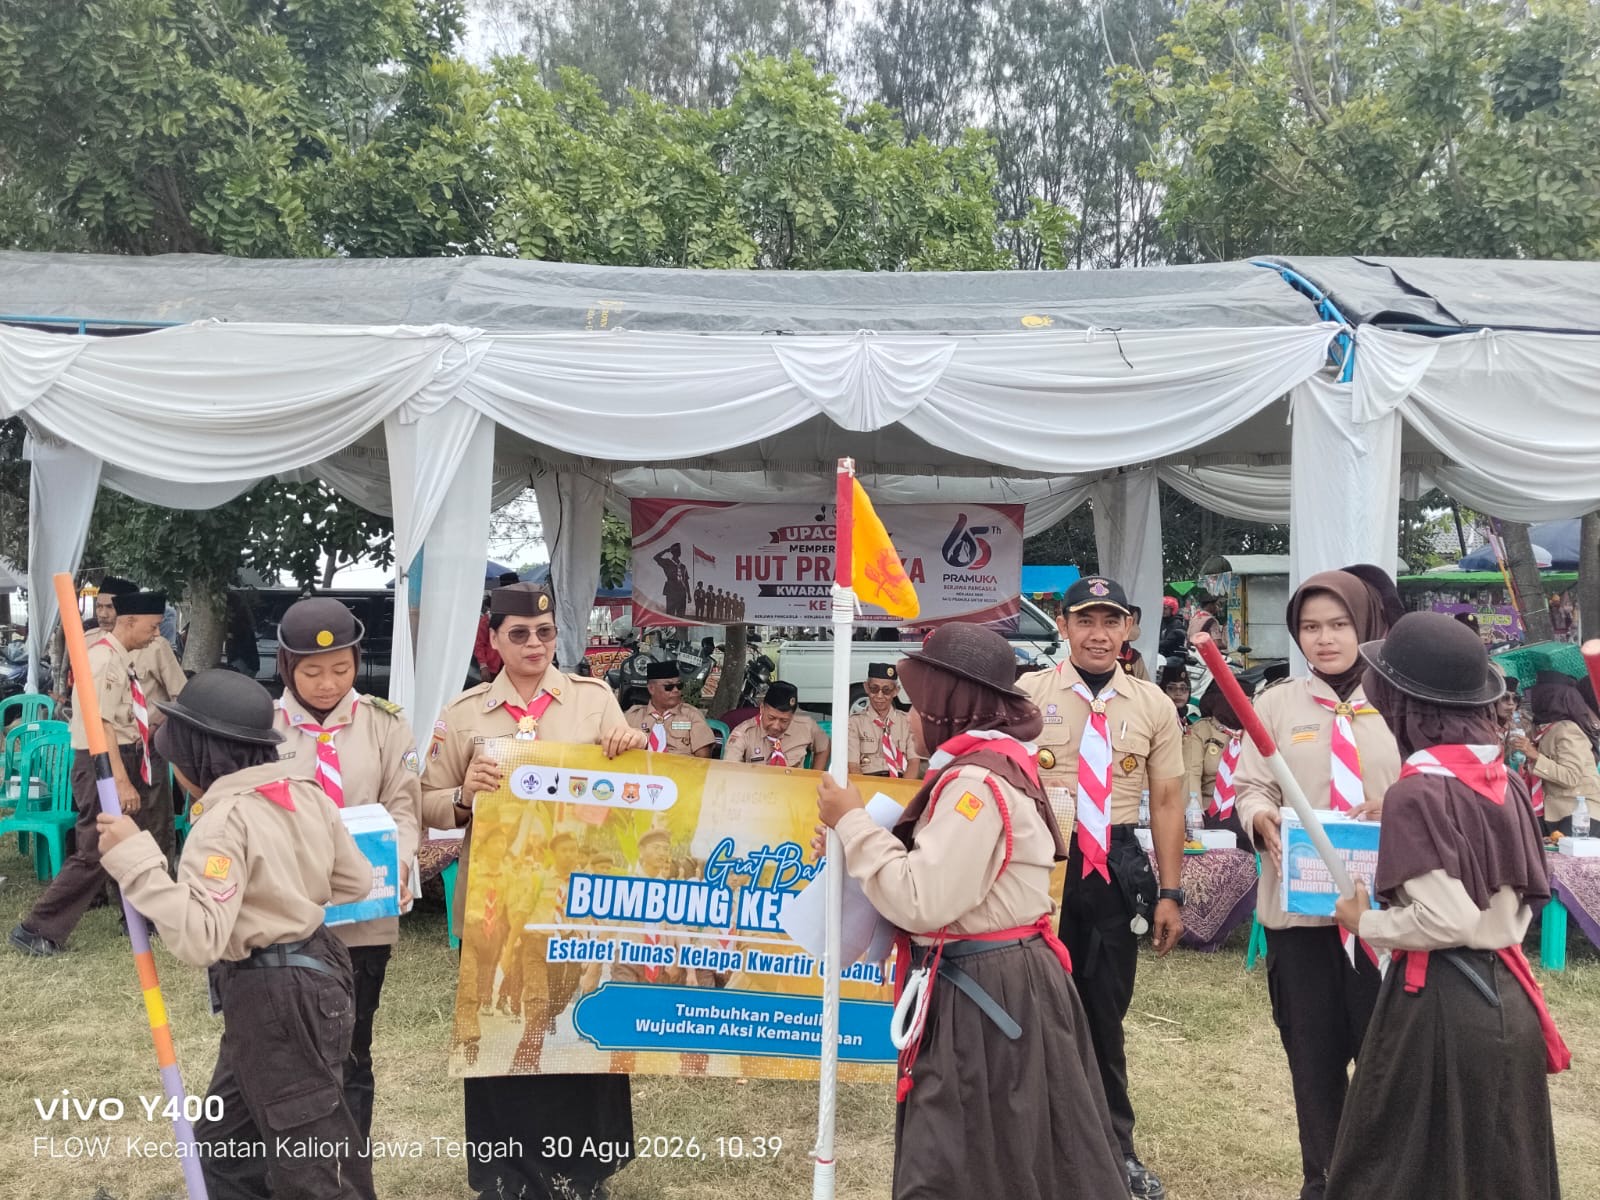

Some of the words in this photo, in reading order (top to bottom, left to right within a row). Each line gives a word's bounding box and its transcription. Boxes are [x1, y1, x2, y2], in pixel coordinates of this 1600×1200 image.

[786, 526, 836, 541] UPAC
[789, 545, 836, 553] MEMPER
[735, 555, 788, 581] HUT
[942, 573, 998, 584] PRAMUKA
[809, 600, 827, 611] KE
[568, 875, 731, 929] BUMBUNG
[548, 938, 614, 962] Estafet
[619, 941, 675, 965] Tunas
[680, 945, 742, 975] Kelapa
[748, 950, 815, 976] Kwartir
[676, 1003, 770, 1023] Tumbuhkan
[774, 1010, 823, 1027] Peduli
[635, 1018, 716, 1037] Wujudkan
[719, 1022, 753, 1037] Aksi
